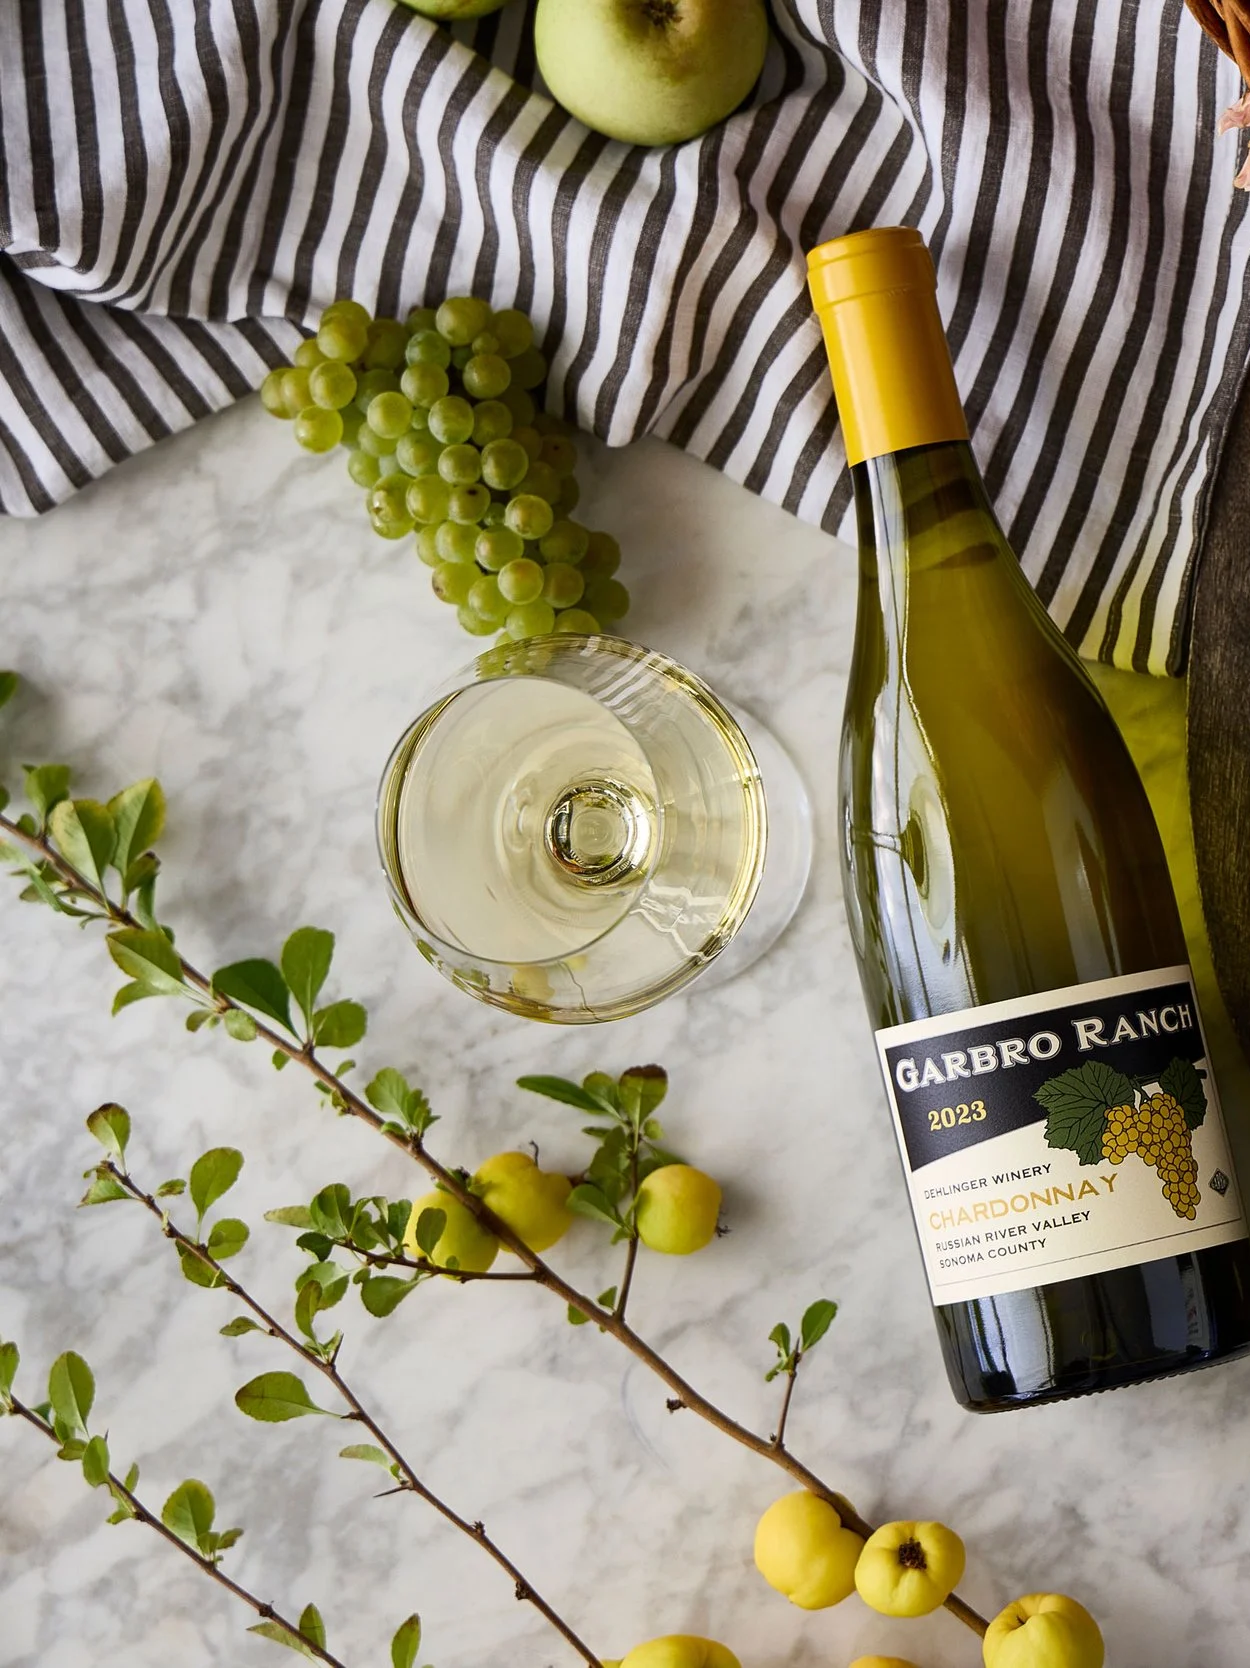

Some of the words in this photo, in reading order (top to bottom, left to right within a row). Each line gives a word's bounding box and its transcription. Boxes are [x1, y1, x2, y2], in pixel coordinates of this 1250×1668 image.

[896, 1031, 1061, 1092] GARBRO
[1072, 1003, 1194, 1051] RANCH
[928, 1100, 987, 1131] 2023
[924, 1178, 988, 1199] DEHLINGER
[991, 1164, 1051, 1185] WINERY
[929, 1173, 1118, 1231] CHARDONNAY
[936, 1235, 981, 1252] RUSSIAN
[985, 1225, 1027, 1243] RIVER
[1032, 1211, 1091, 1232] VALLEY
[940, 1252, 984, 1269] SONOMA
[988, 1239, 1047, 1259] COUNTY
